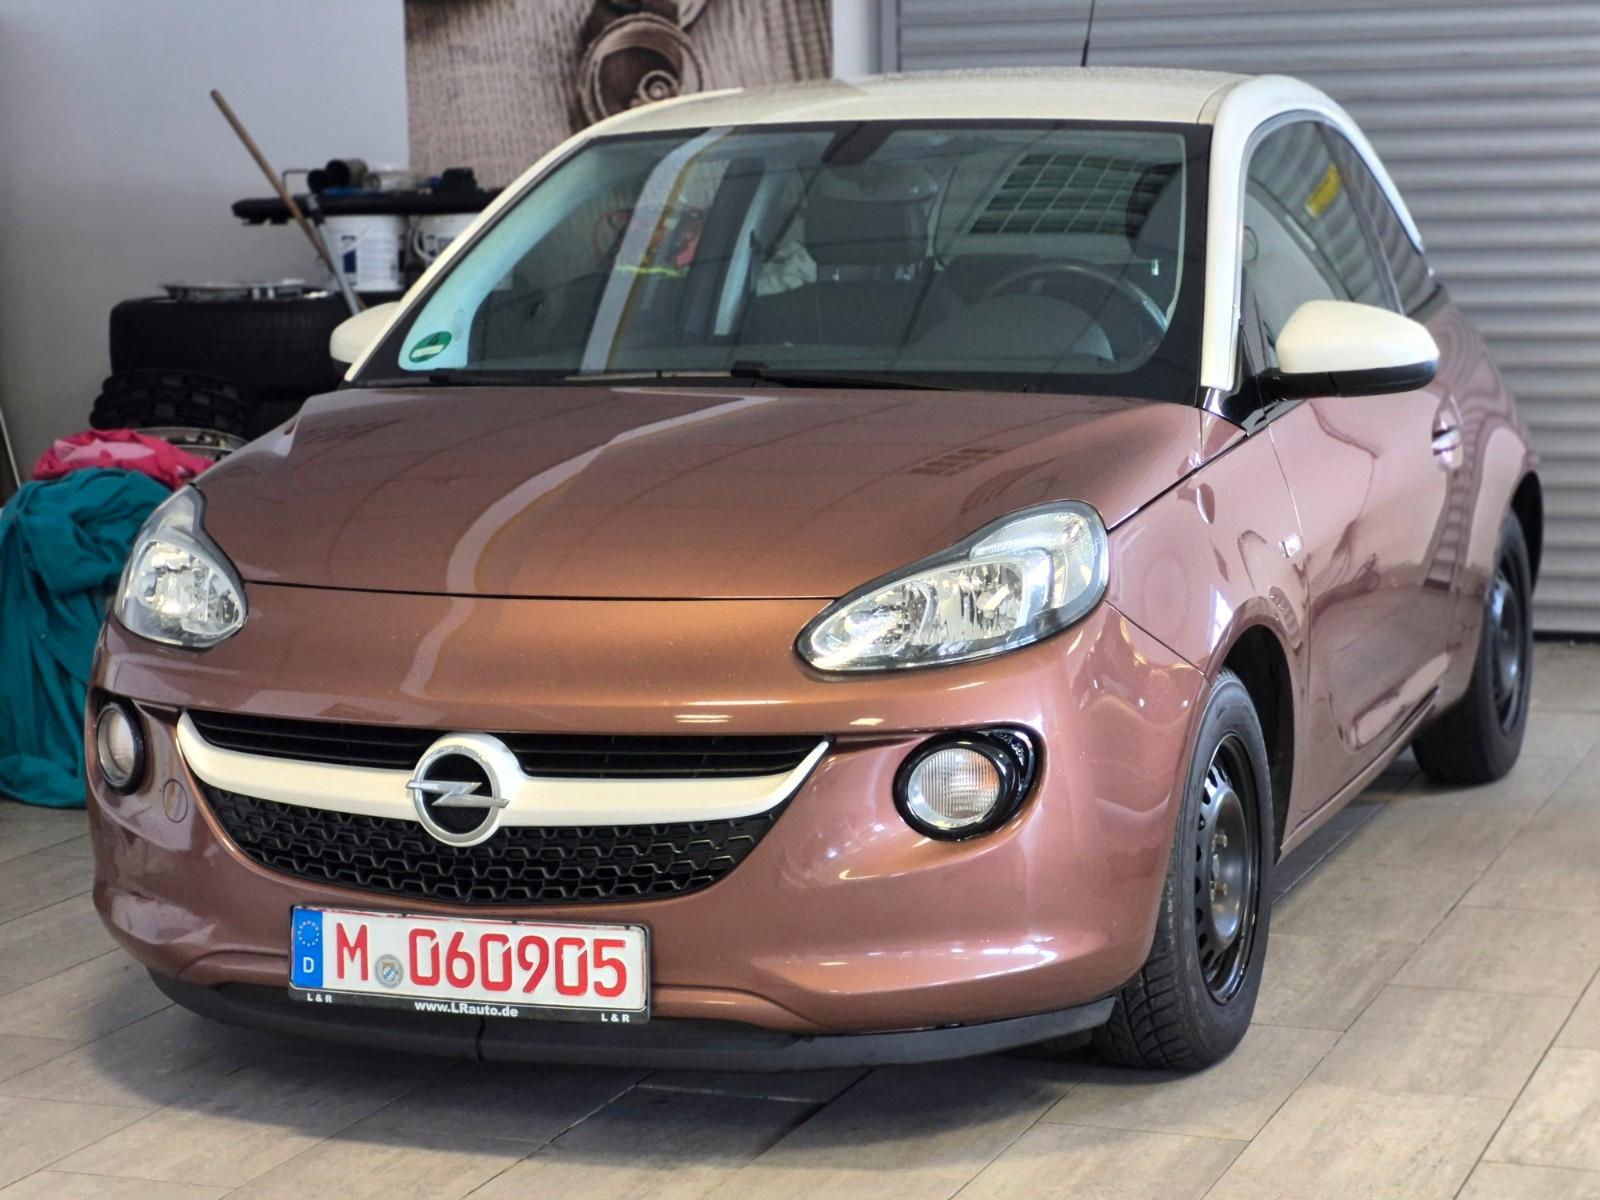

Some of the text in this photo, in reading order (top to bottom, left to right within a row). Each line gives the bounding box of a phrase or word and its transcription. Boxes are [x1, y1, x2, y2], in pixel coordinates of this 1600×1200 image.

[303, 956, 315, 973] D
[336, 922, 627, 998] M 060905
[307, 993, 333, 1003] L & R
[414, 1001, 519, 1018] www.LRauto.de
[601, 1012, 630, 1023] L & R
